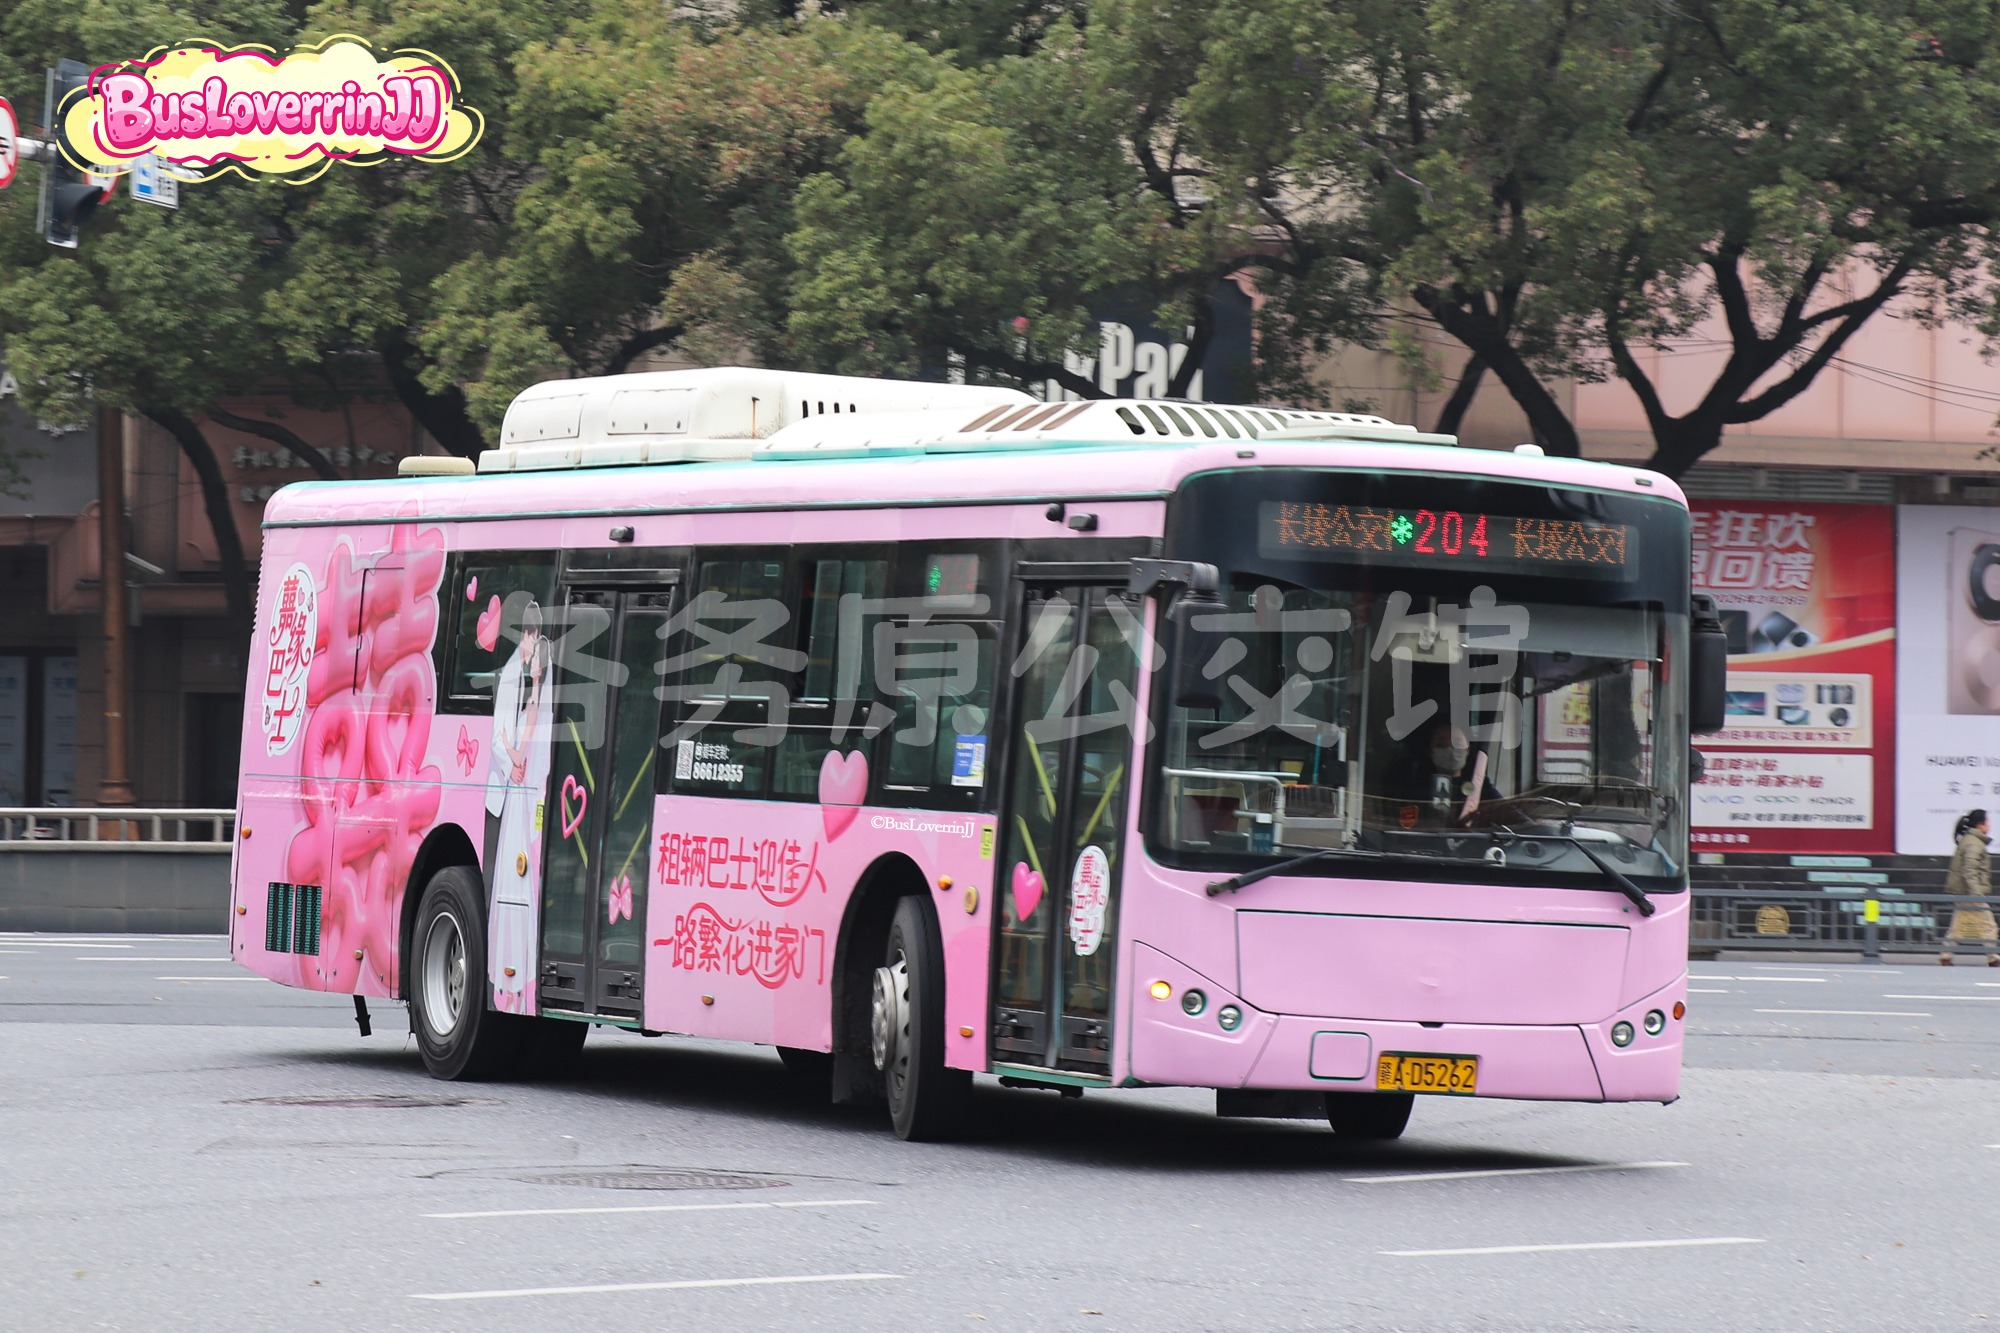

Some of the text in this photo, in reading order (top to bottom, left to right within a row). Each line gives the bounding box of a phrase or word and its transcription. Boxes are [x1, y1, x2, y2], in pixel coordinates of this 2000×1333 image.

[1413, 509, 1489, 557] 204
[657, 832, 828, 907] 租辆巴士迎佳人
[653, 902, 826, 990] 一路繁花进家门
